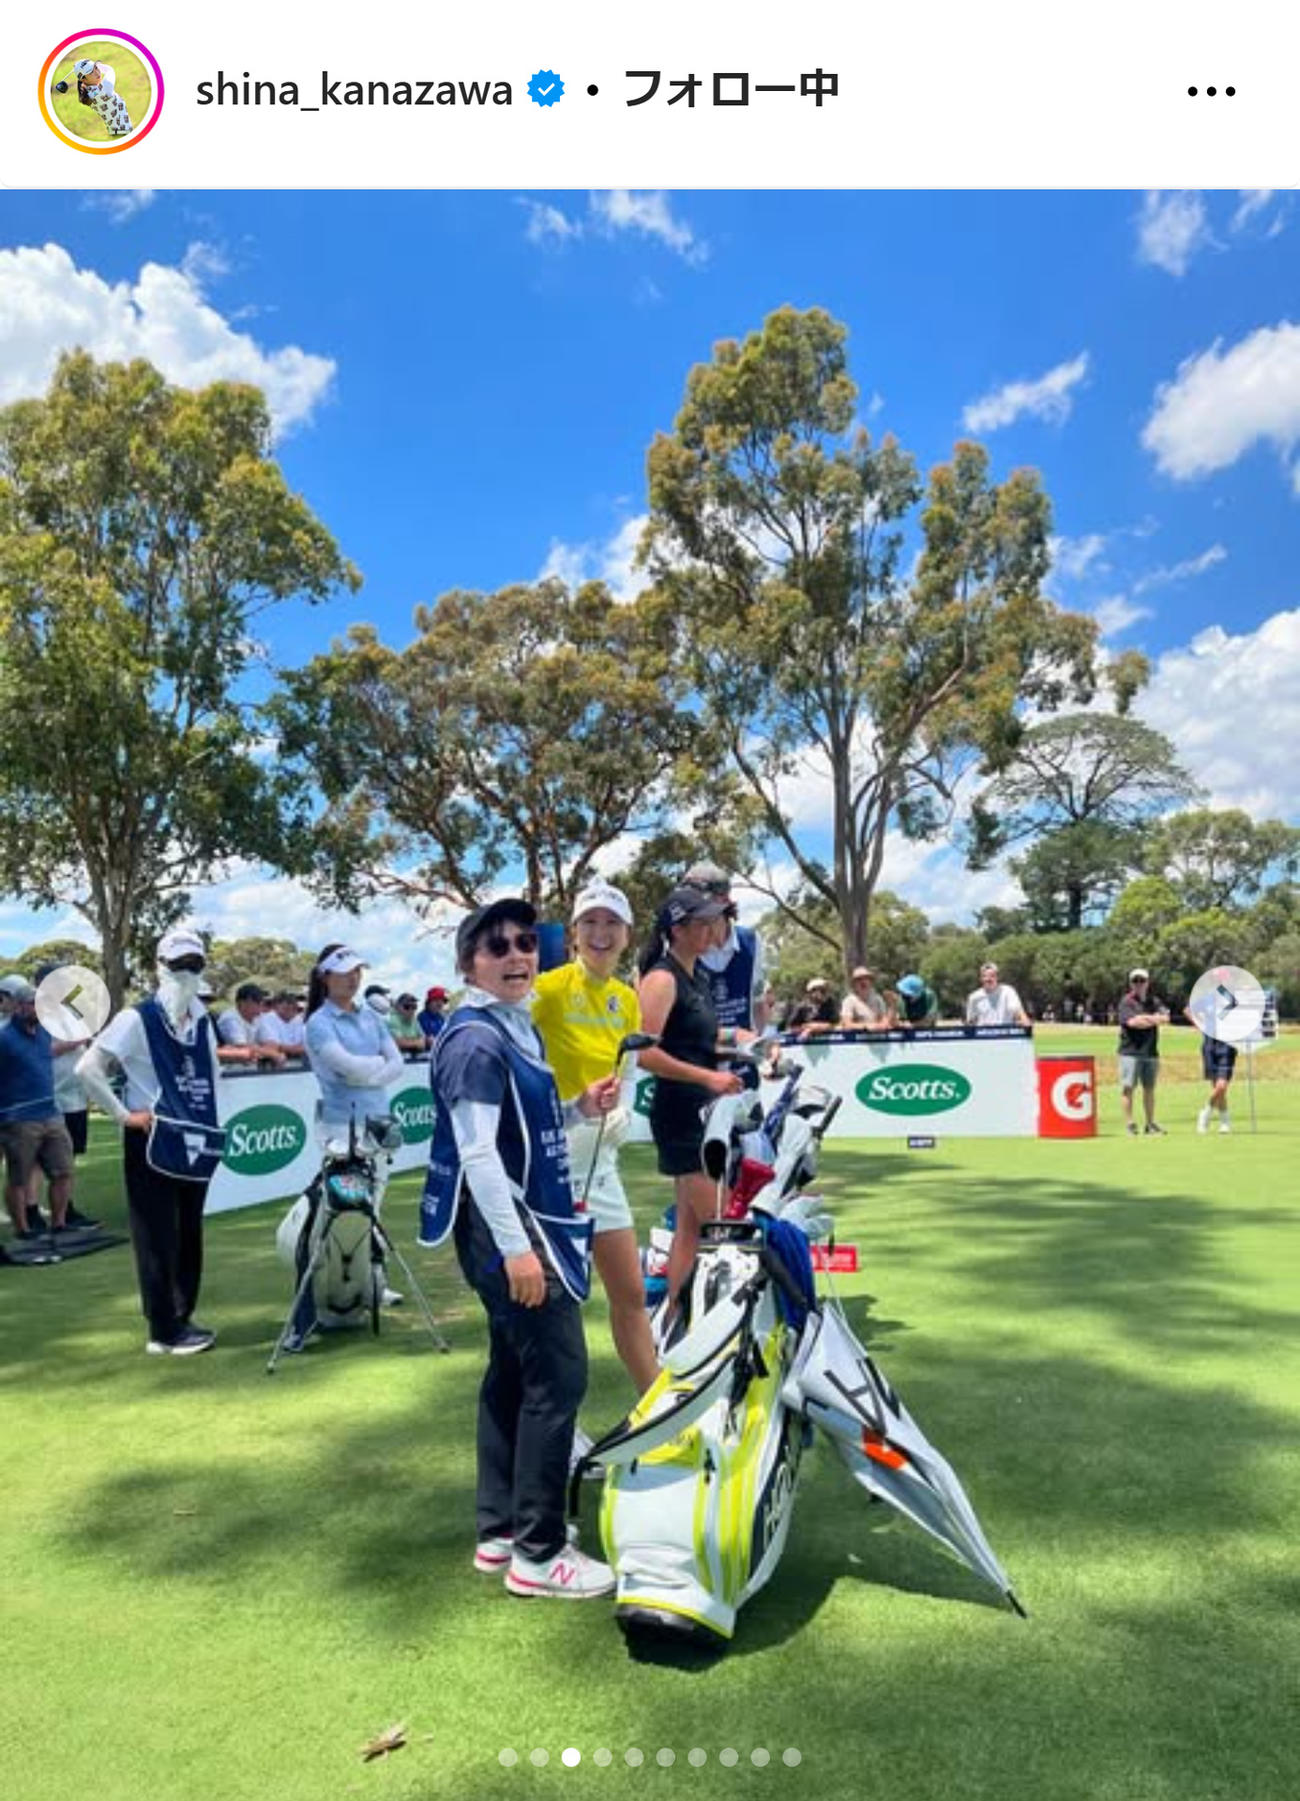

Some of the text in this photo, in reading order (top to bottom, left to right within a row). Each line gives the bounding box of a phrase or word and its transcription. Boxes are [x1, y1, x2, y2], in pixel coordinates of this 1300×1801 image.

[868, 1076, 957, 1100] Scotts
[1050, 1071, 1093, 1119] G
[228, 1122, 297, 1157] Scotts
